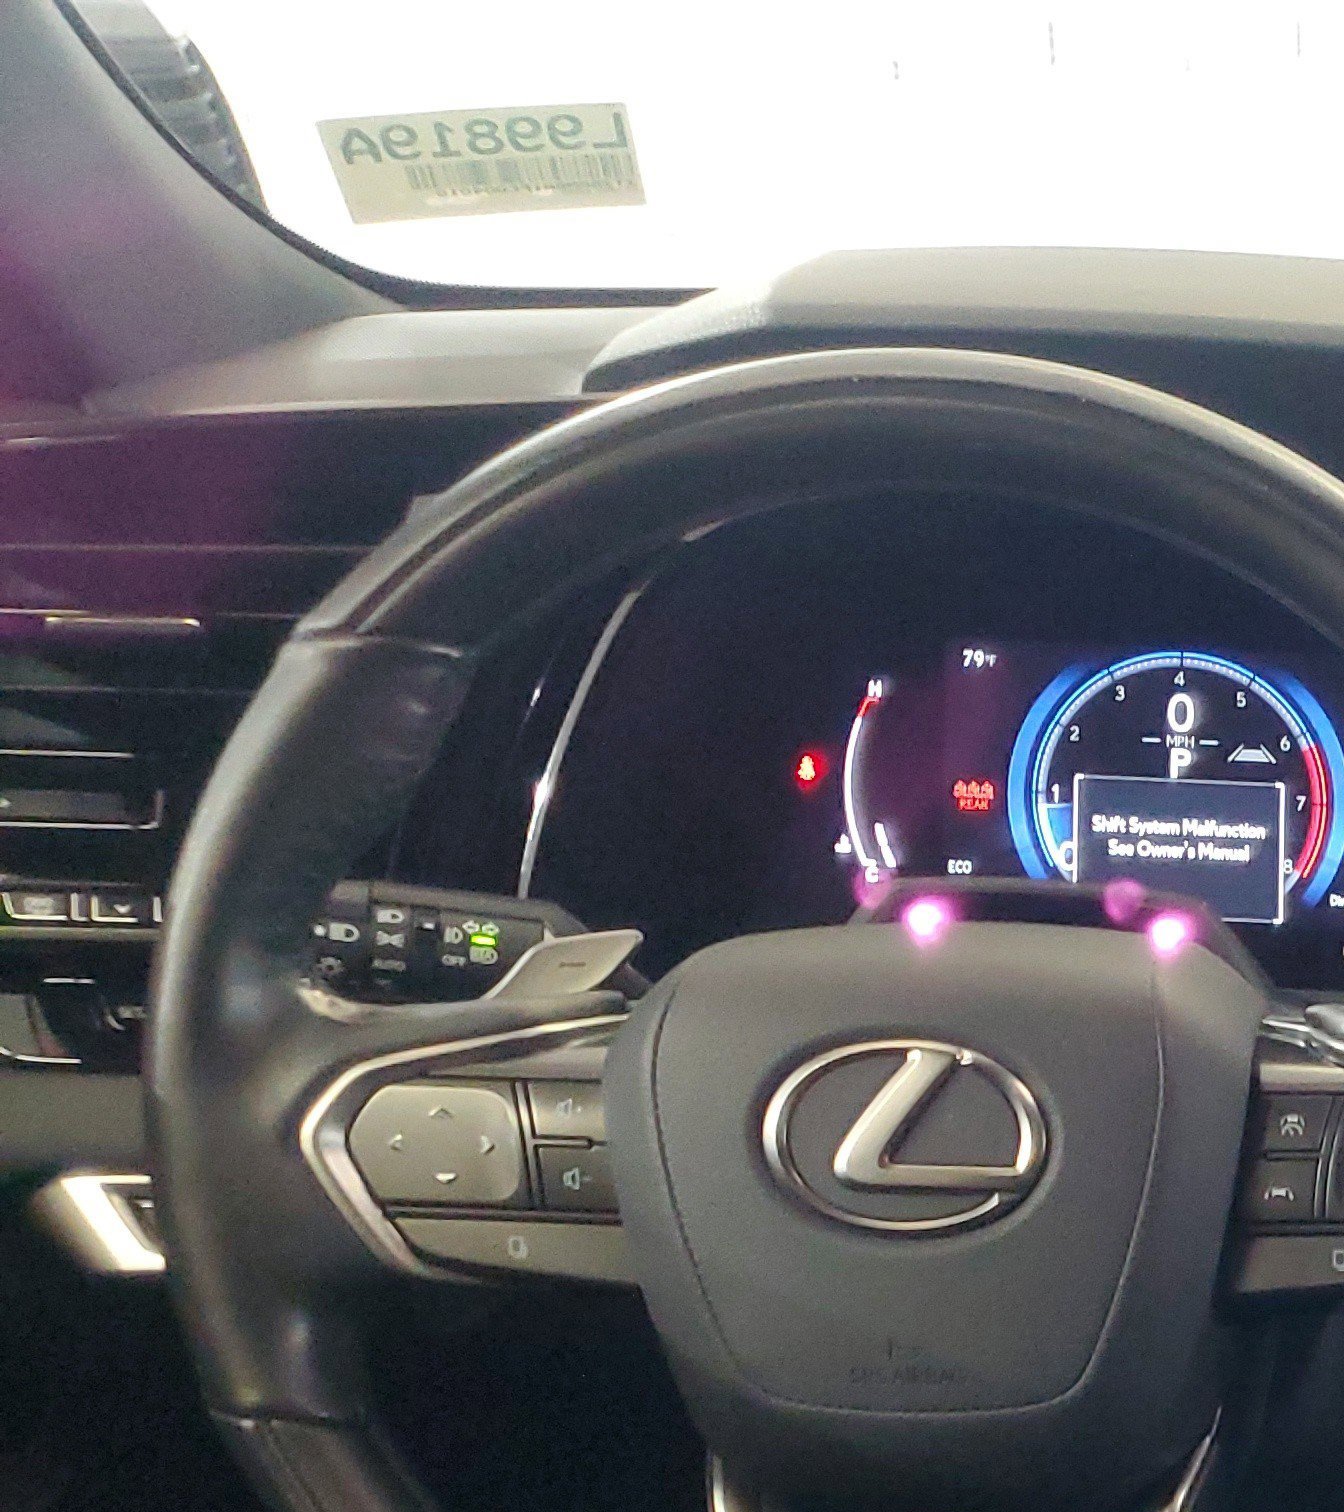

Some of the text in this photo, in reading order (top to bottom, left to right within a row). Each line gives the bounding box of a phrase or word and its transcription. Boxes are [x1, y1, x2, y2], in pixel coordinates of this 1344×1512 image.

[1173, 671, 1185, 687] 4
[1115, 685, 1126, 701] 3
[1236, 691, 1247, 708] 5
[1166, 693, 1195, 733] 0
[1069, 725, 1080, 742] 2
[1166, 734, 1195, 748] MPH
[1279, 735, 1291, 752] 6
[1169, 748, 1192, 779] P
[1051, 783, 1060, 804] 1
[1295, 795, 1306, 812] 7
[1091, 814, 1266, 840] Shift System Malfunction
[1107, 838, 1250, 863] See Owner's Manual
[947, 859, 973, 874] ECO
[1283, 858, 1293, 874] 8
